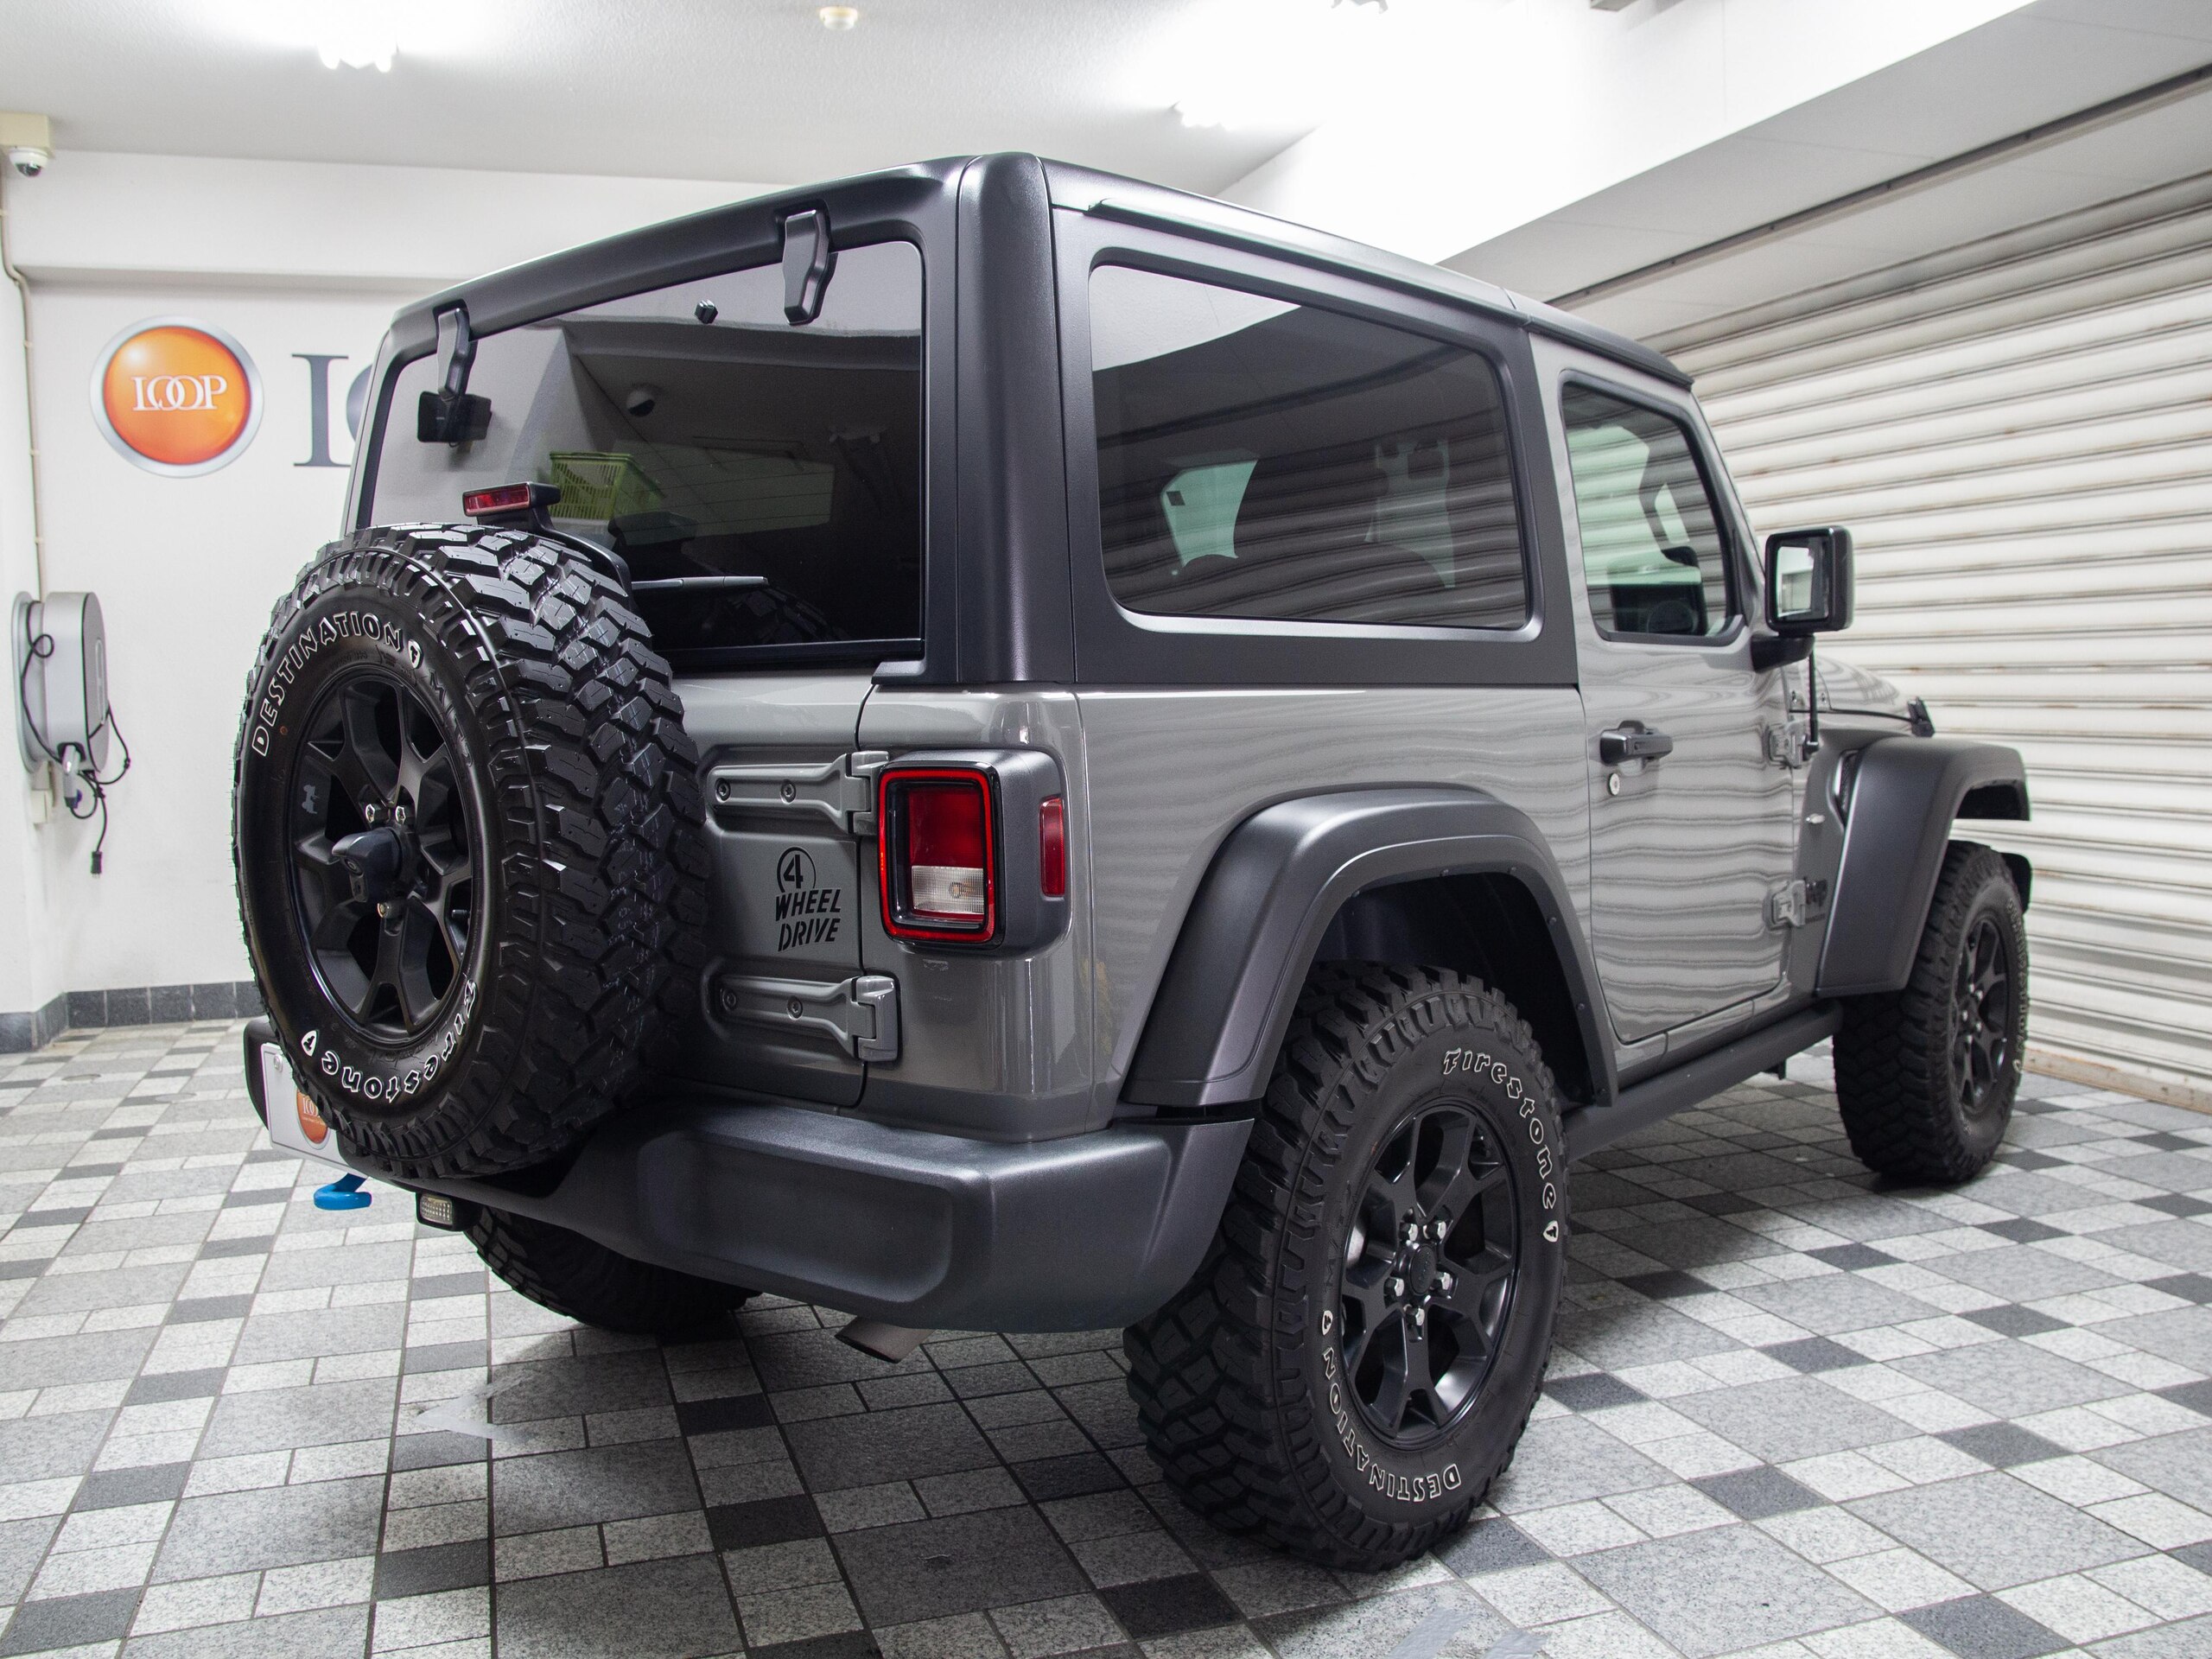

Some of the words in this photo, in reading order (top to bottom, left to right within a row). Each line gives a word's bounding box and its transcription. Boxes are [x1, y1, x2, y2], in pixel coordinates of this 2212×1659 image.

[130, 374, 227, 411] LOOP
[251, 611, 403, 757] DESTINATION
[775, 889, 841, 922] WHEEL
[783, 854, 804, 889] 4
[778, 918, 841, 952] DRIVE
[321, 980, 476, 1103] Firestone
[1443, 1047, 1556, 1210] Firestone
[1323, 1347, 1462, 1503] DESTINATION
